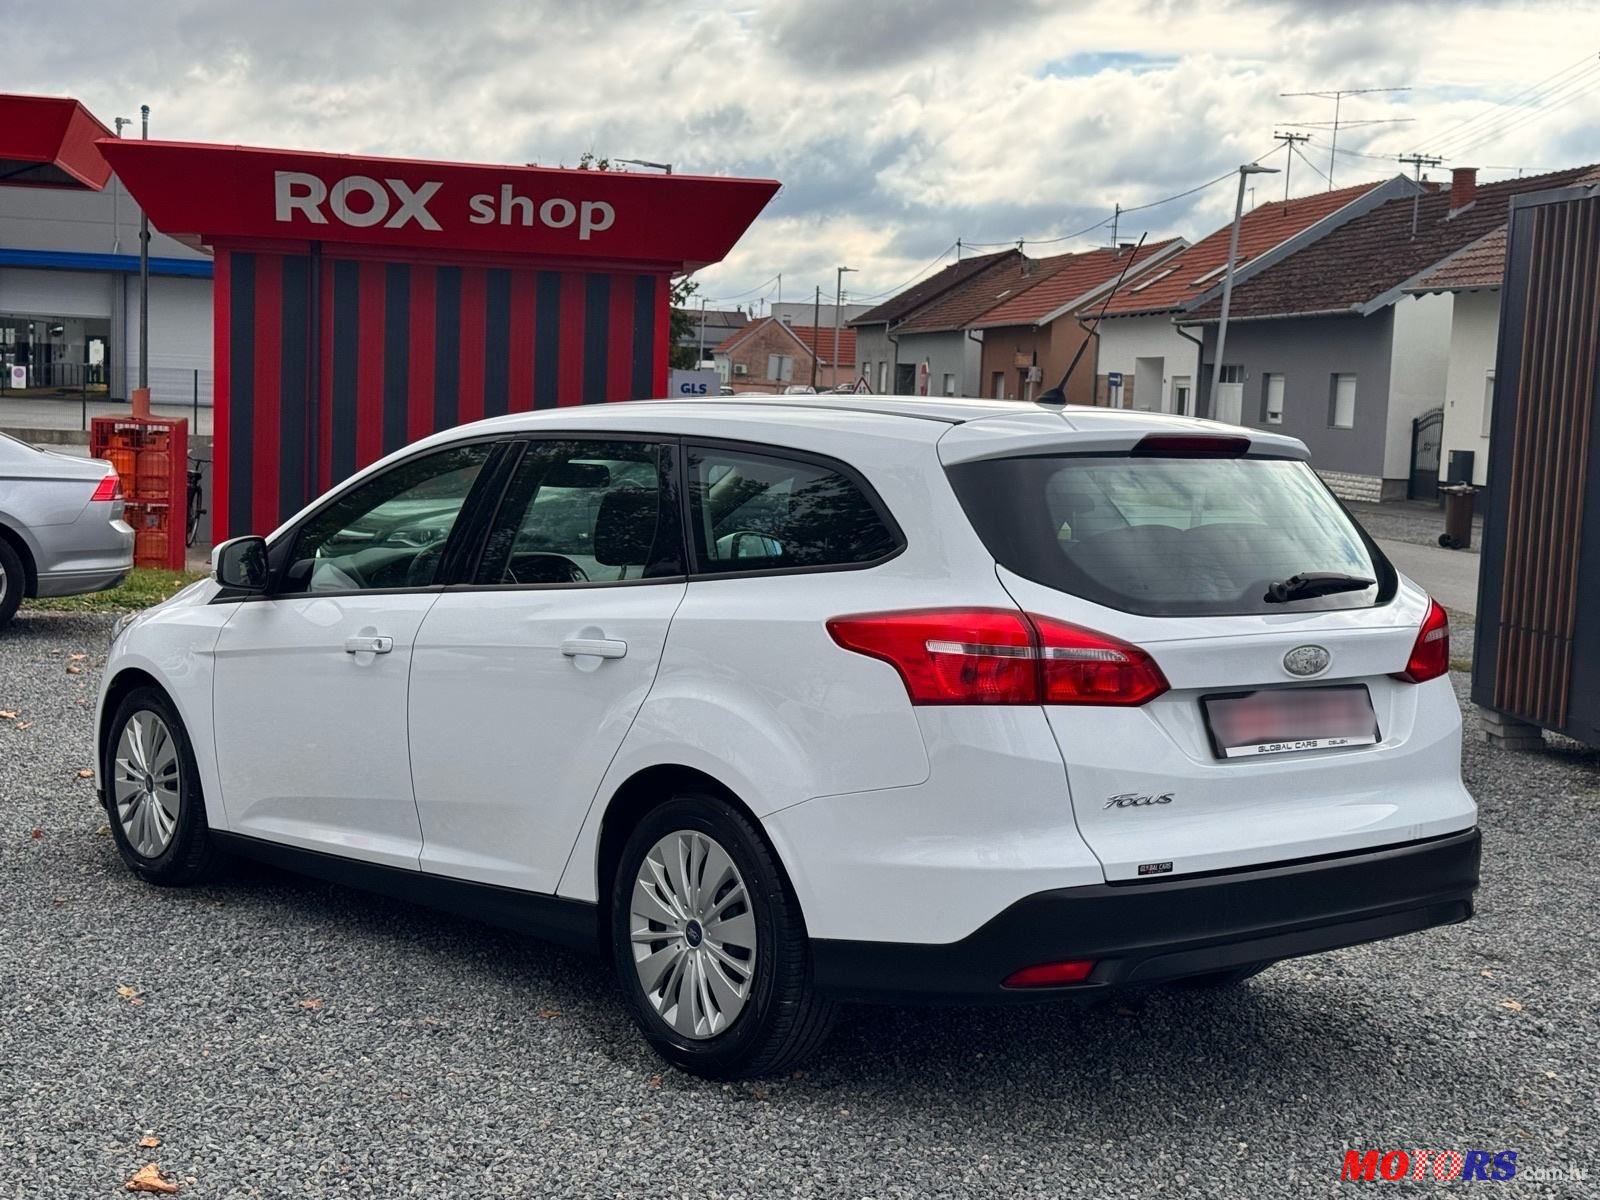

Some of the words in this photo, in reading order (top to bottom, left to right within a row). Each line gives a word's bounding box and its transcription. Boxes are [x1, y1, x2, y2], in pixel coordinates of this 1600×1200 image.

[274, 170, 444, 232] ROX
[468, 183, 616, 241] shop
[680, 383, 707, 394] GLS
[1258, 744, 1292, 753] GLOBAL
[1295, 740, 1318, 749] CARS
